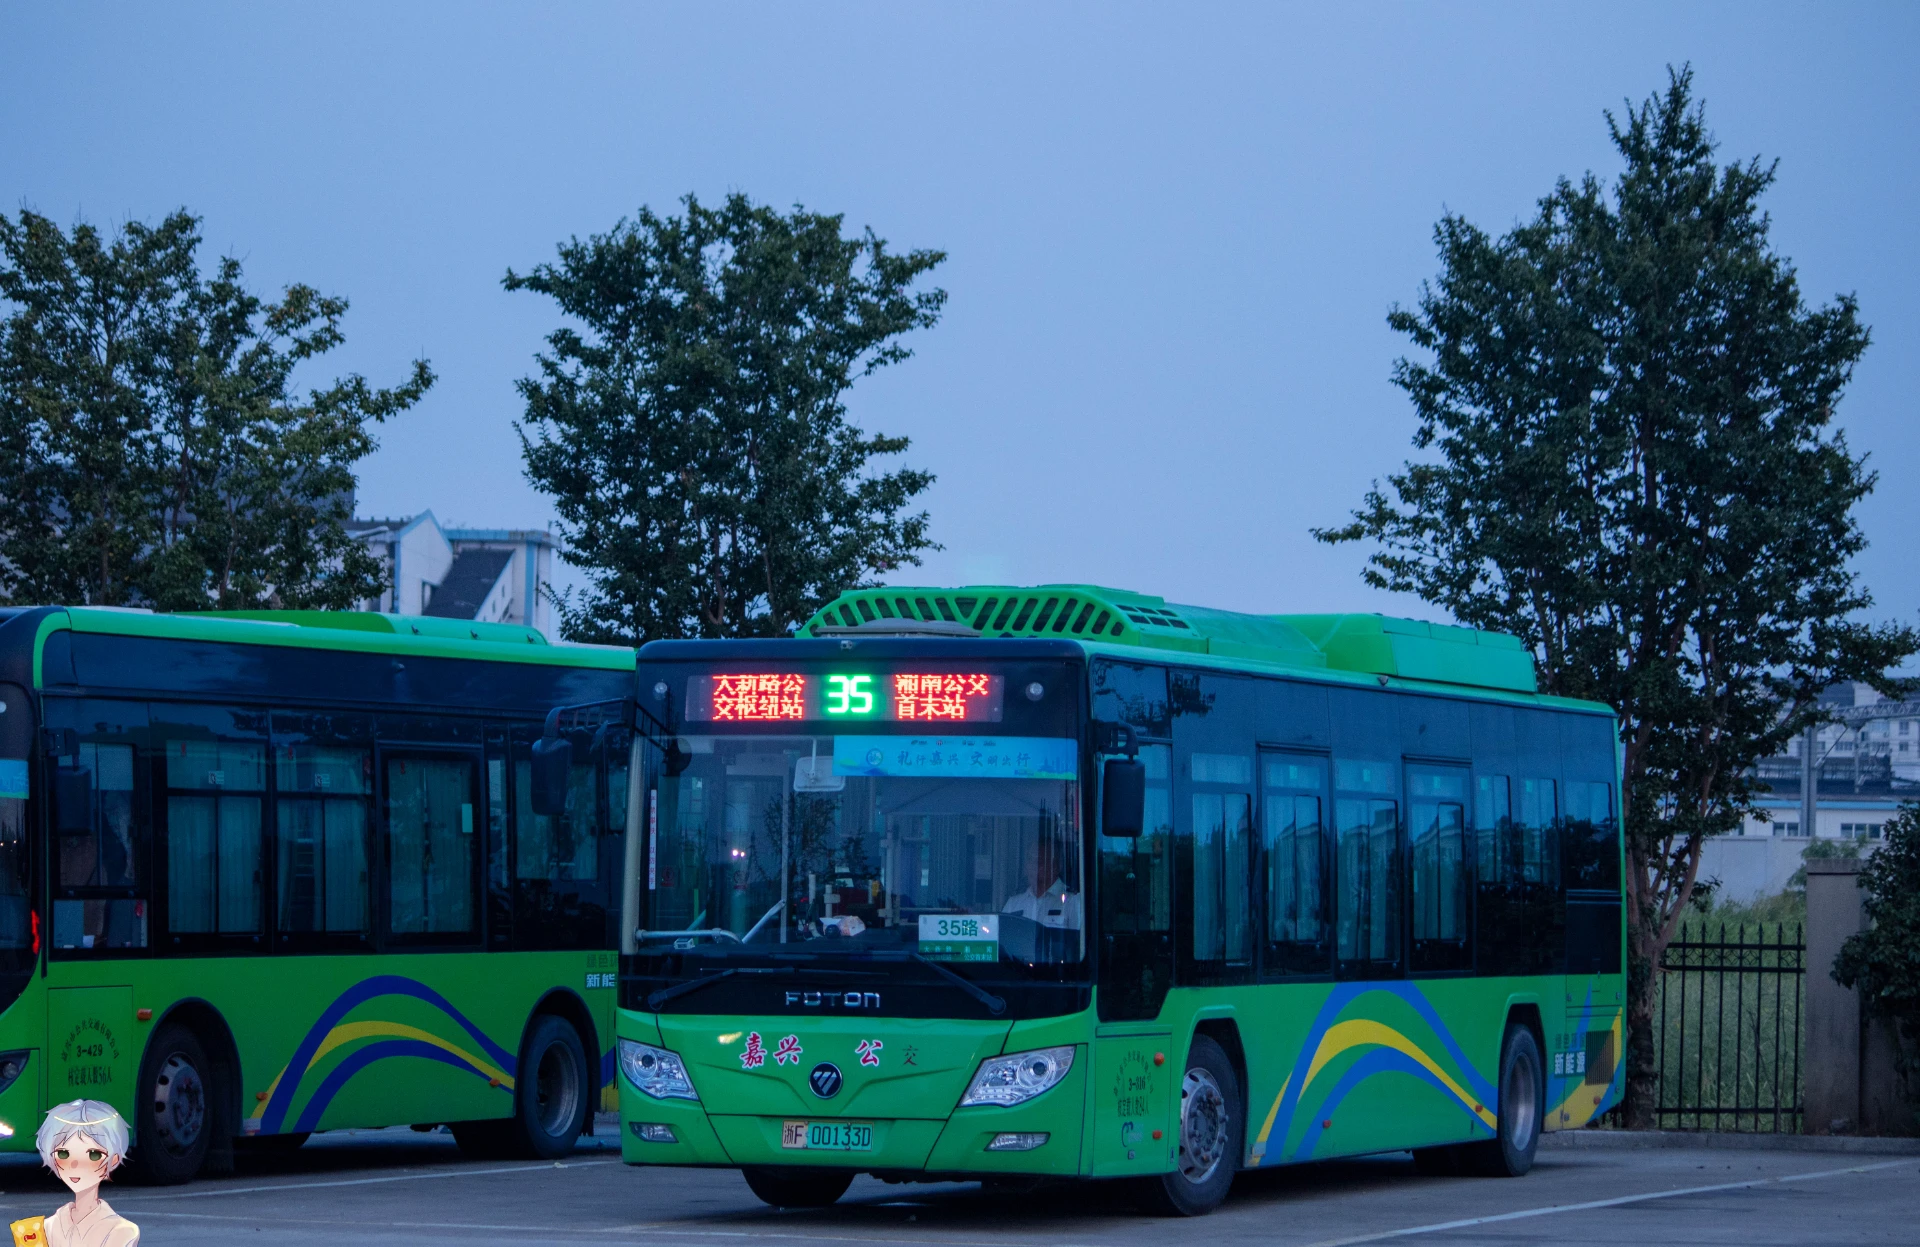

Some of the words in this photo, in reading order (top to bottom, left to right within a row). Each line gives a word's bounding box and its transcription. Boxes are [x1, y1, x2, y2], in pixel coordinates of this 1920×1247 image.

[827, 674, 873, 714] 35
[712, 694, 805, 720] 交枢纽站
[894, 694, 967, 720] 首末站
[937, 919, 978, 937] 35路
[785, 991, 881, 1008] FOTON
[76, 1044, 103, 1058] 3-429
[739, 1031, 802, 1069] 嘉兴
[1128, 1075, 1146, 1092] 3-316
[811, 1125, 872, 1147] 00133D
